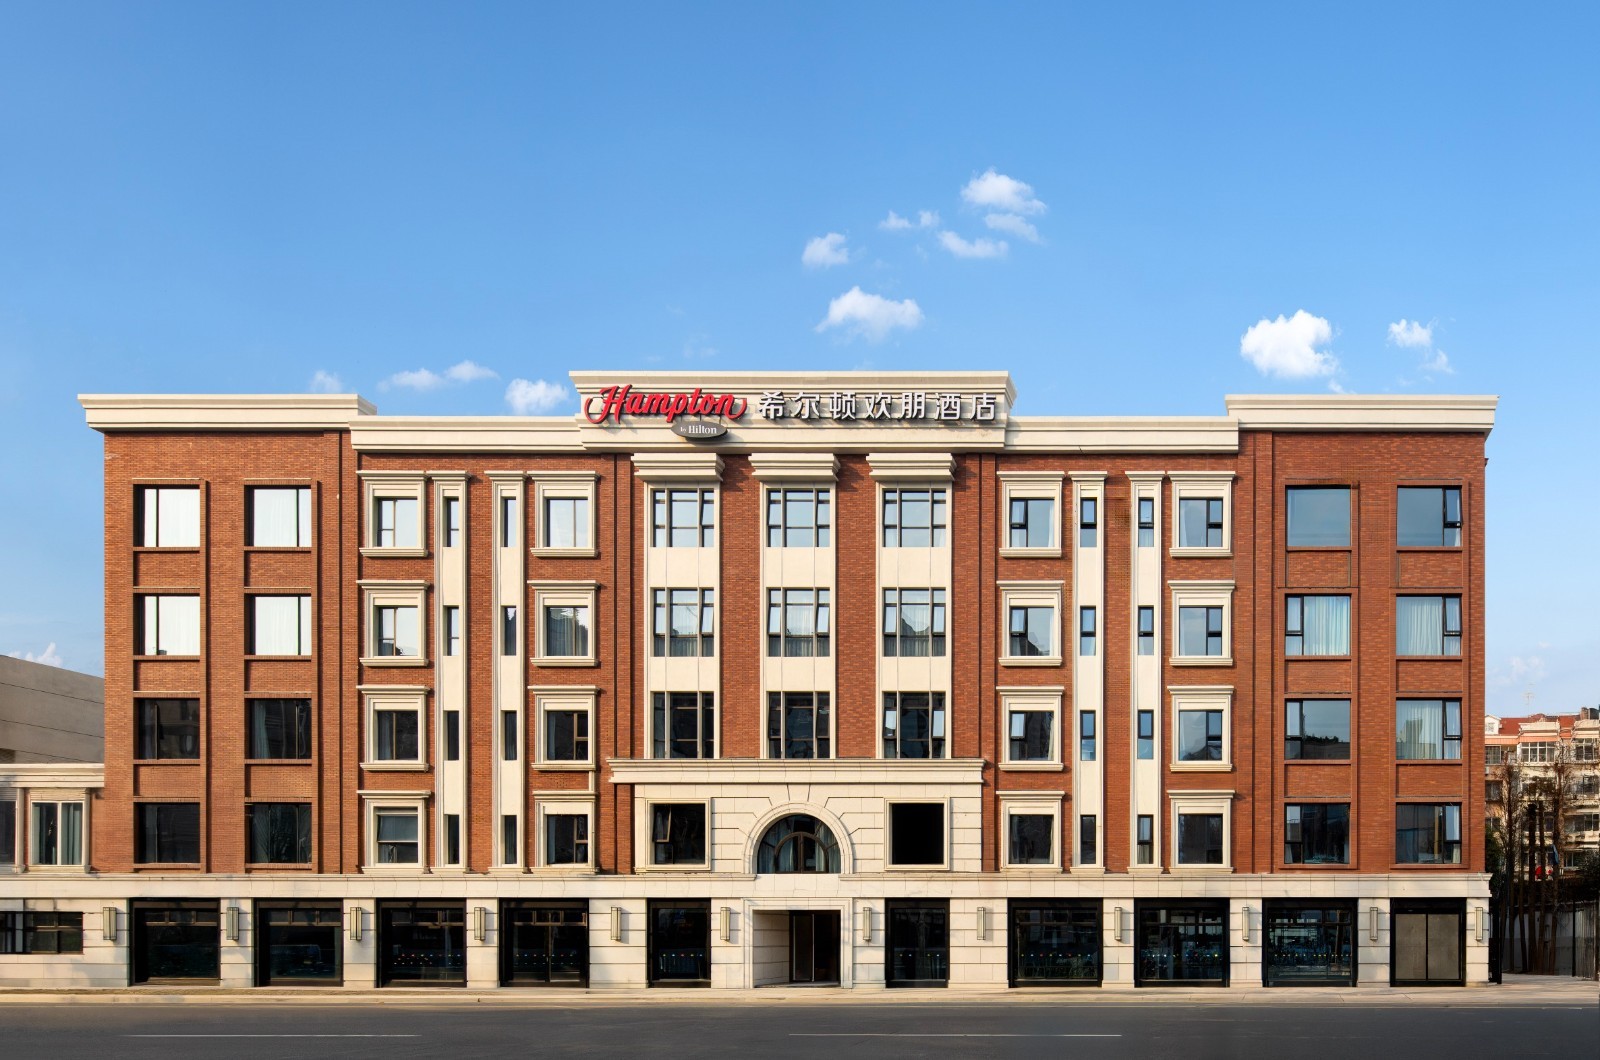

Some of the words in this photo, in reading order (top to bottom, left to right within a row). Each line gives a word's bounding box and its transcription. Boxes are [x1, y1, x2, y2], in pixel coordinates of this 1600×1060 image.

[584, 384, 747, 424] Hampton
[759, 391, 996, 420] 希尔顿欢朋酒店
[688, 424, 717, 434] Hilton
